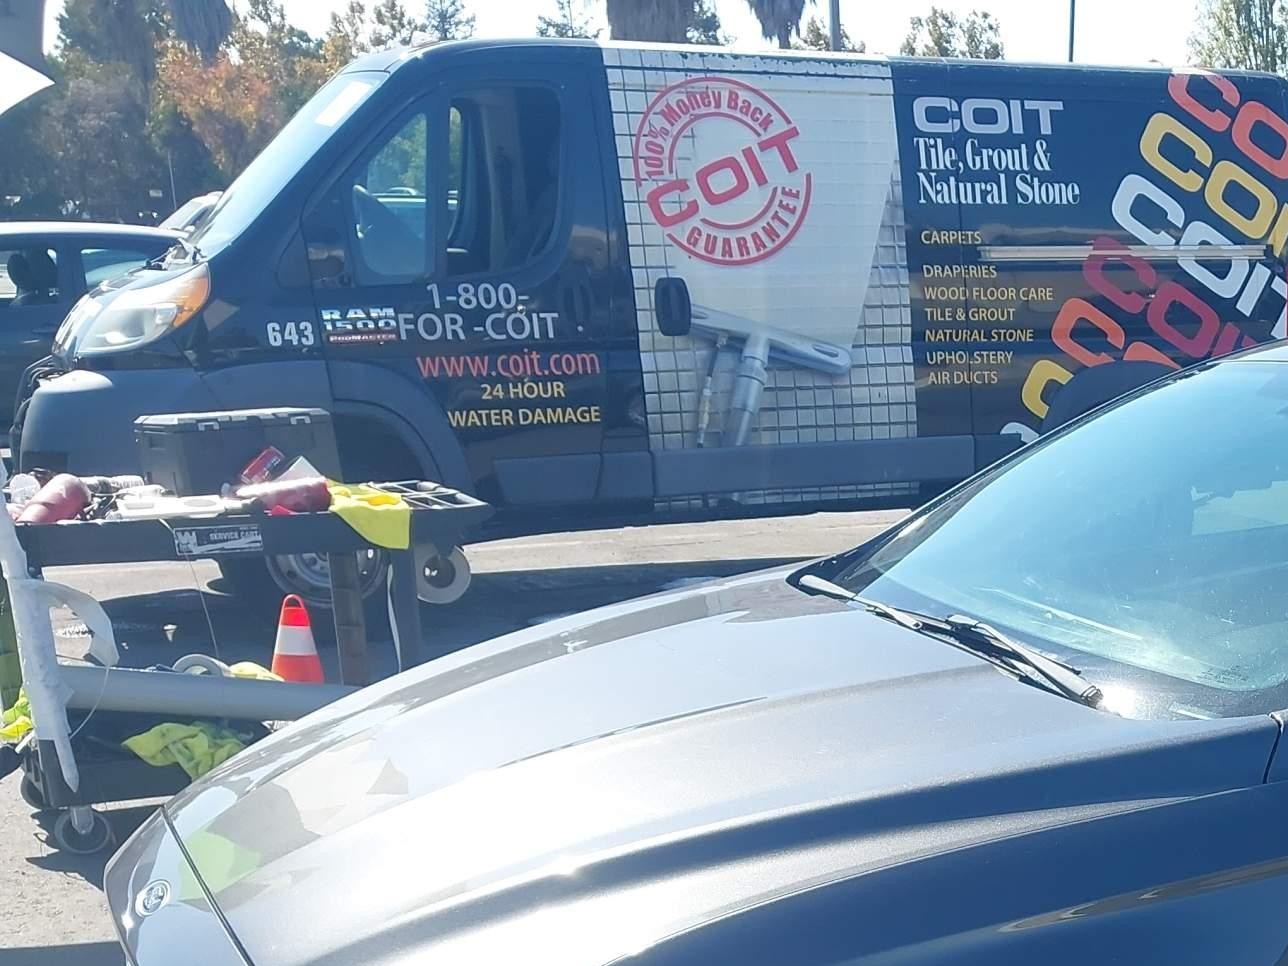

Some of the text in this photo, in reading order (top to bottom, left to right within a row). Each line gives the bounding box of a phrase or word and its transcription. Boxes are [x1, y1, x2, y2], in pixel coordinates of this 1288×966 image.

[913, 96, 1064, 135] COIT
[645, 89, 774, 177] 100% Money Back
[913, 137, 1052, 174] Tile, Grout &
[647, 126, 800, 228] COIT
[917, 172, 1081, 205] Natural Stone
[686, 186, 800, 258] GUARANTEE
[921, 230, 982, 244] CARPETS
[922, 265, 998, 278] DRAPERIES
[426, 283, 530, 309] 1-800-
[924, 287, 1054, 300] WOOD FLOOR CARE
[321, 307, 395, 320] RAM
[924, 308, 1016, 321] TILE & GROUT
[267, 321, 314, 347] 643
[323, 319, 397, 331] 1500
[397, 313, 466, 341] FOR
[925, 329, 1034, 342] NATURAL STONE
[416, 350, 600, 379] www.coit.com
[926, 351, 1013, 364] UPHOLSTERY
[928, 371, 998, 384] AIR DUCTS
[480, 381, 566, 400] 24 HOUR
[447, 406, 601, 427] WATER DAMAGE
